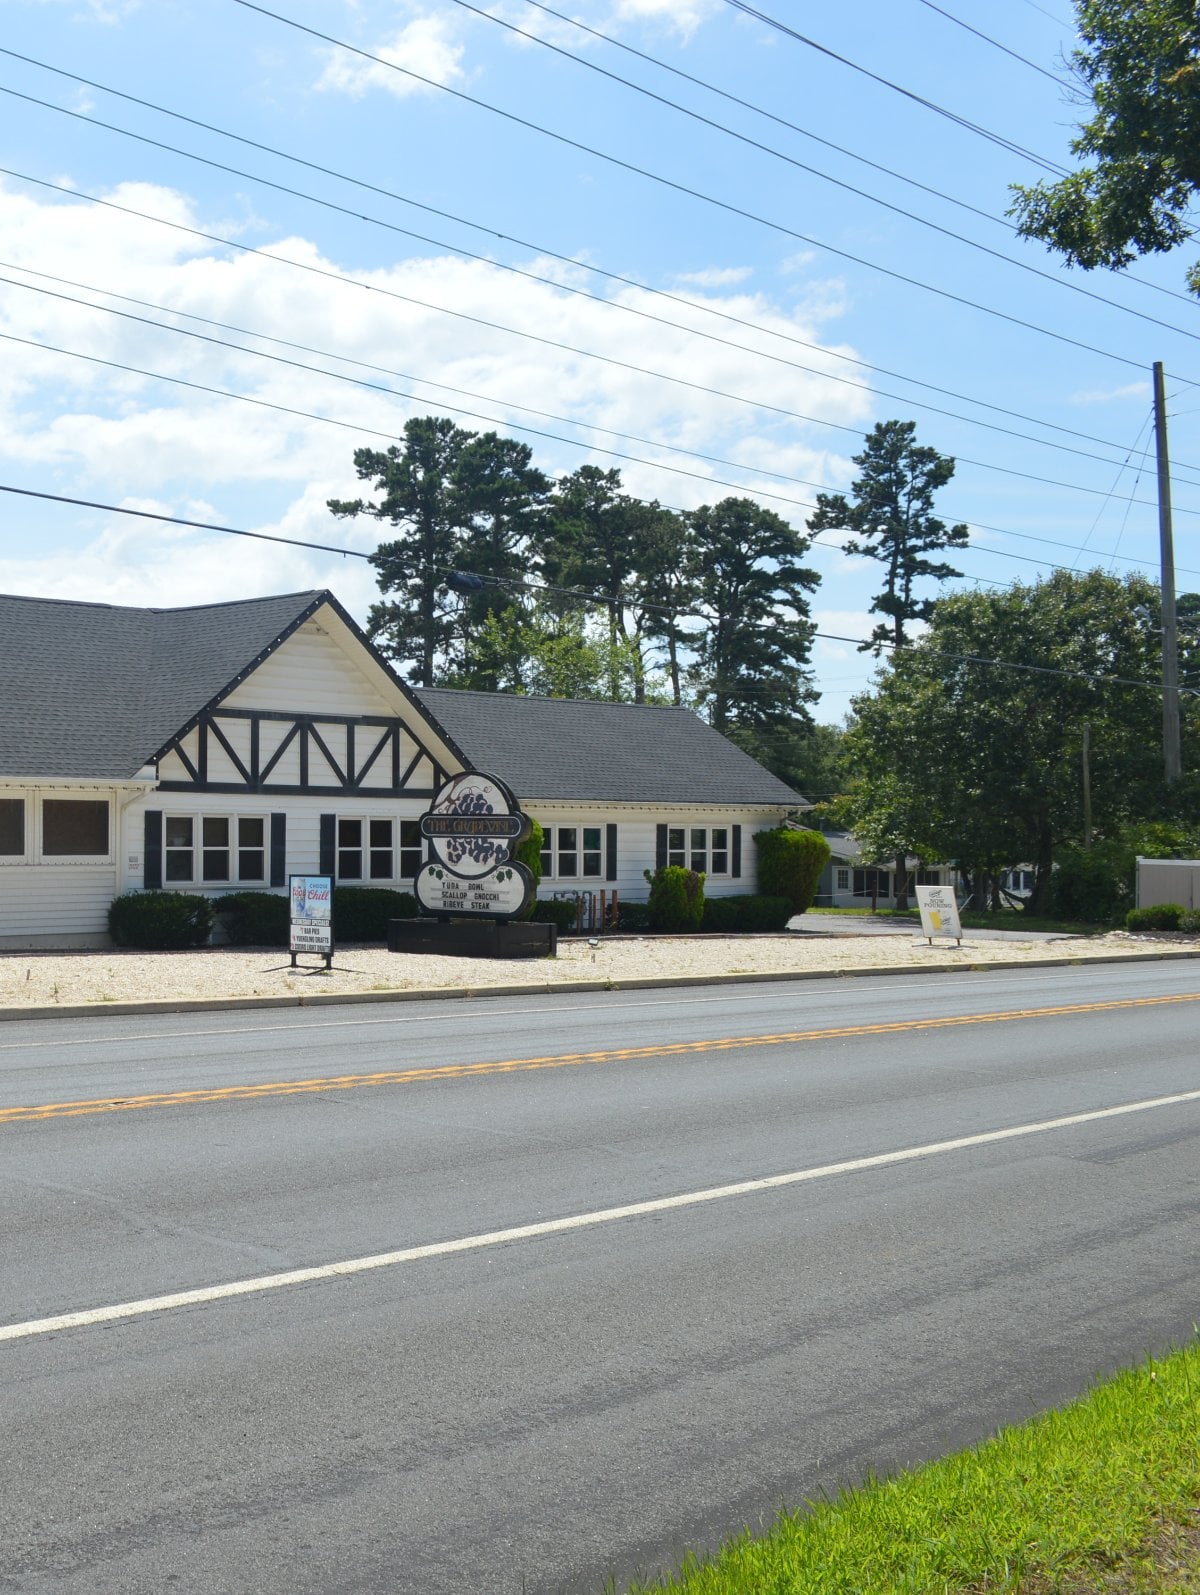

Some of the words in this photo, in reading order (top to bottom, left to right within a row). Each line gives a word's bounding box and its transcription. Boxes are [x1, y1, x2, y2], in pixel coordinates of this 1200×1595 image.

[468, 883, 484, 891] BOWL
[308, 889, 328, 900] Chill
[441, 891, 468, 900] SCALLOP
[474, 892, 500, 901] GNOCCHI
[443, 900, 465, 909] RIBEYE
[471, 901, 490, 910] STEAK
